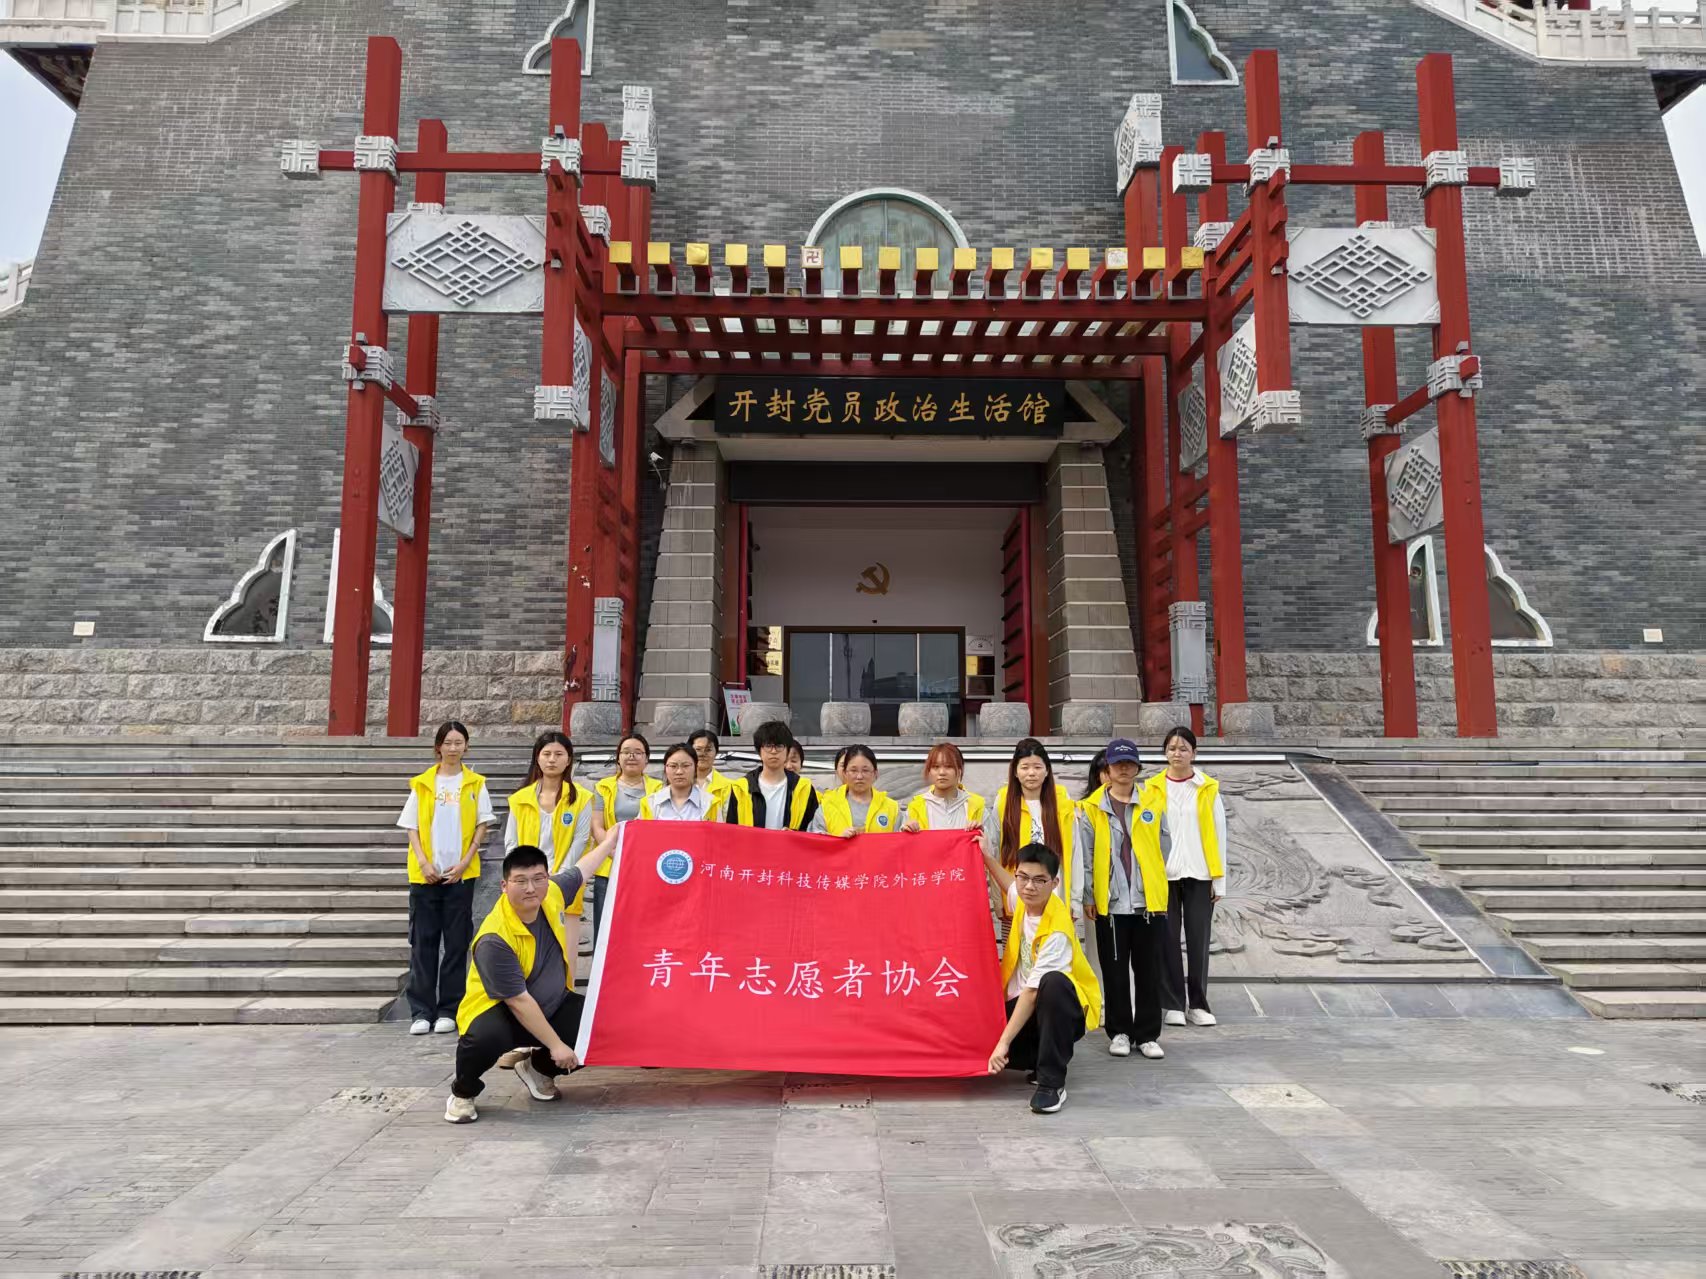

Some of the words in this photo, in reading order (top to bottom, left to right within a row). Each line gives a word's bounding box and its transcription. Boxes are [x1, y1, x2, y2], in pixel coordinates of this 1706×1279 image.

[728, 388, 1051, 425] 开封党员政治生活馆
[700, 861, 966, 891] 河南开封科技传媒学院外语学院
[642, 948, 969, 999] 青年志愿者协会
